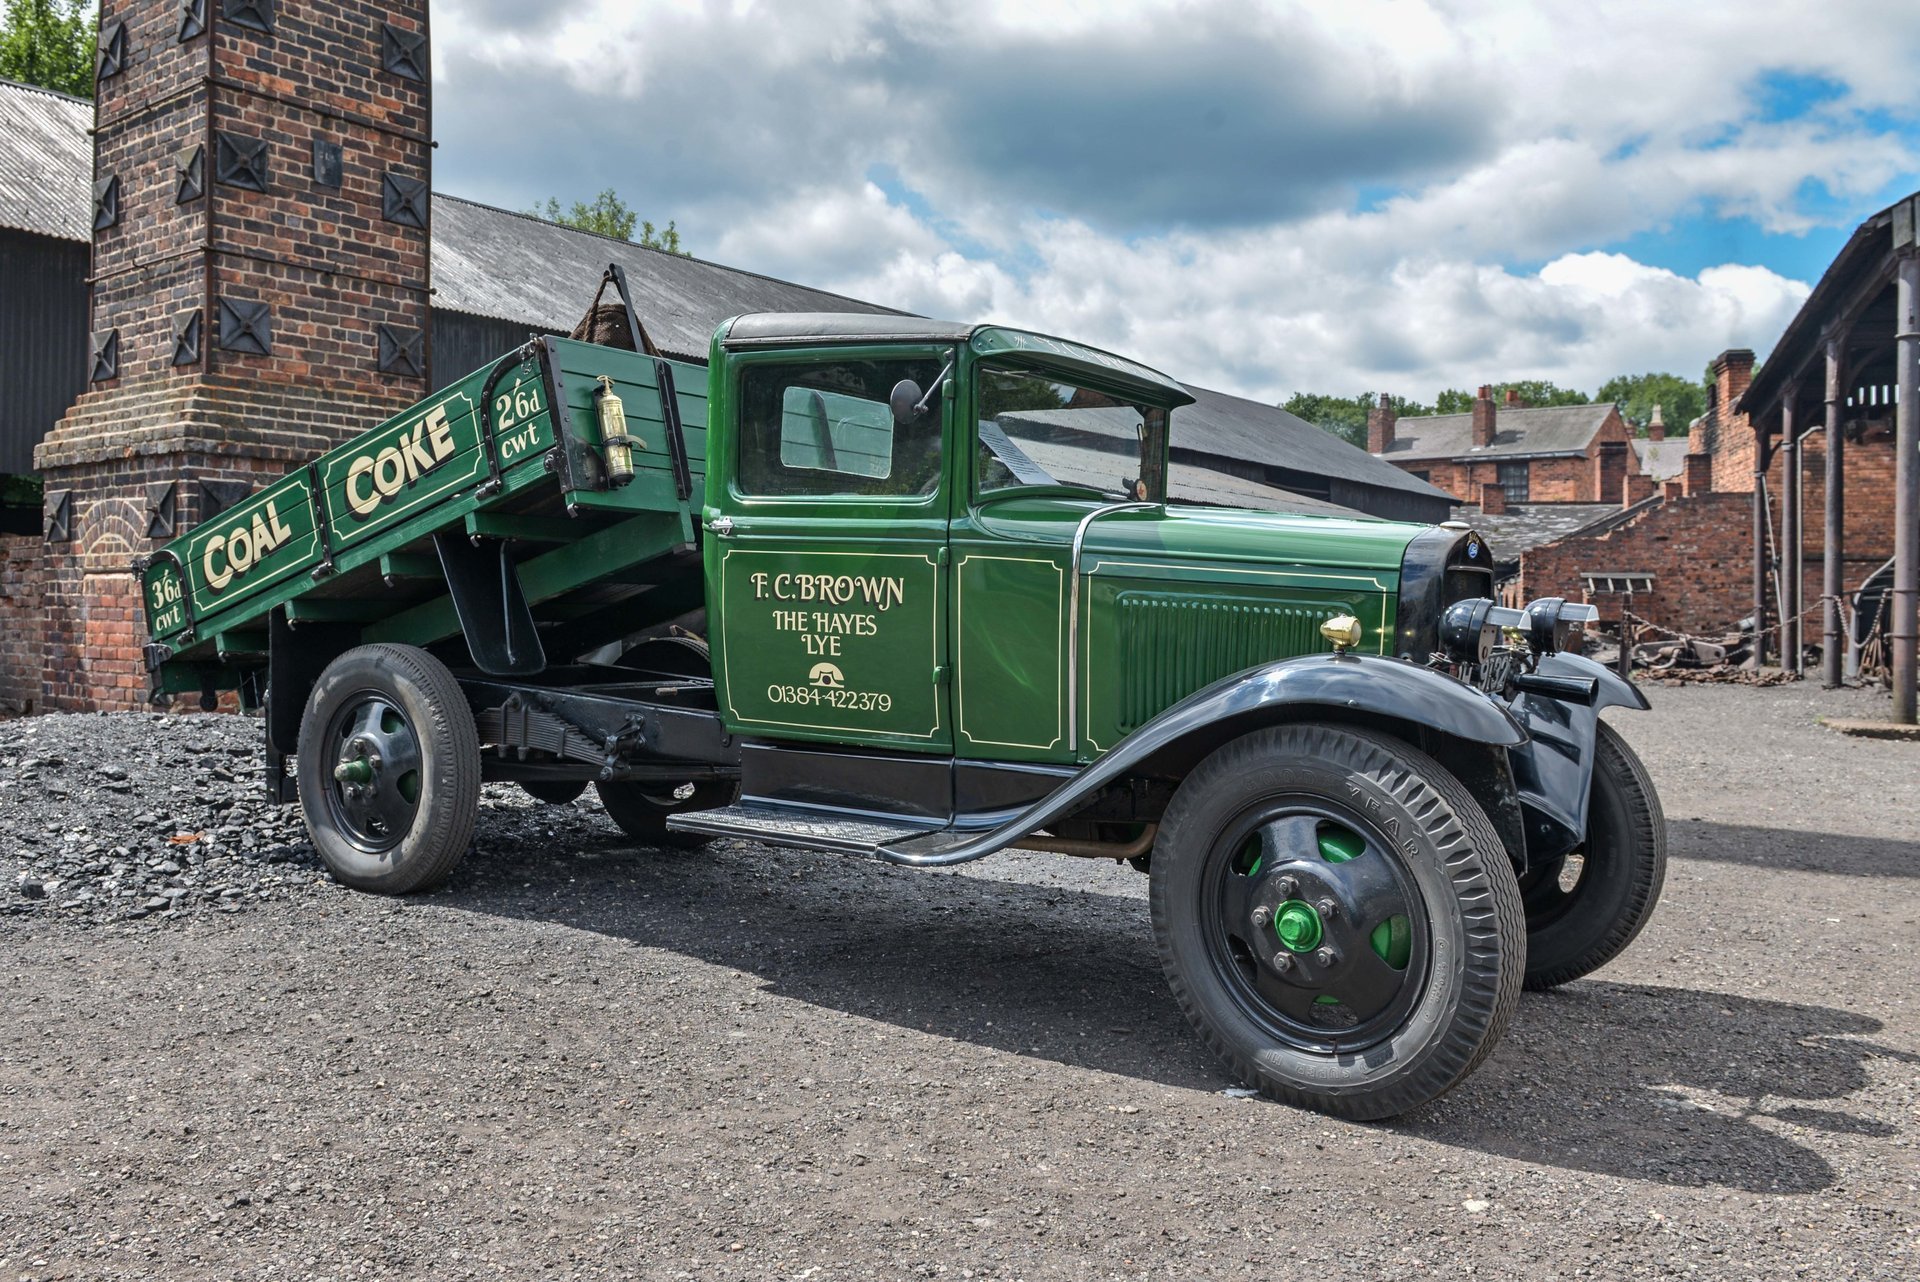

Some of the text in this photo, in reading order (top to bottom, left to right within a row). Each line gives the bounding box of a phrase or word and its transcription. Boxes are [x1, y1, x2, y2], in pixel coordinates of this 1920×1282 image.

[501, 422, 540, 458] cwt
[346, 405, 455, 514] COKE
[204, 500, 292, 589] COAL
[156, 605, 181, 631] cwt
[772, 610, 877, 635] THE HAYES
[801, 634, 842, 656] LYE
[767, 685, 892, 712] 01384-422379
